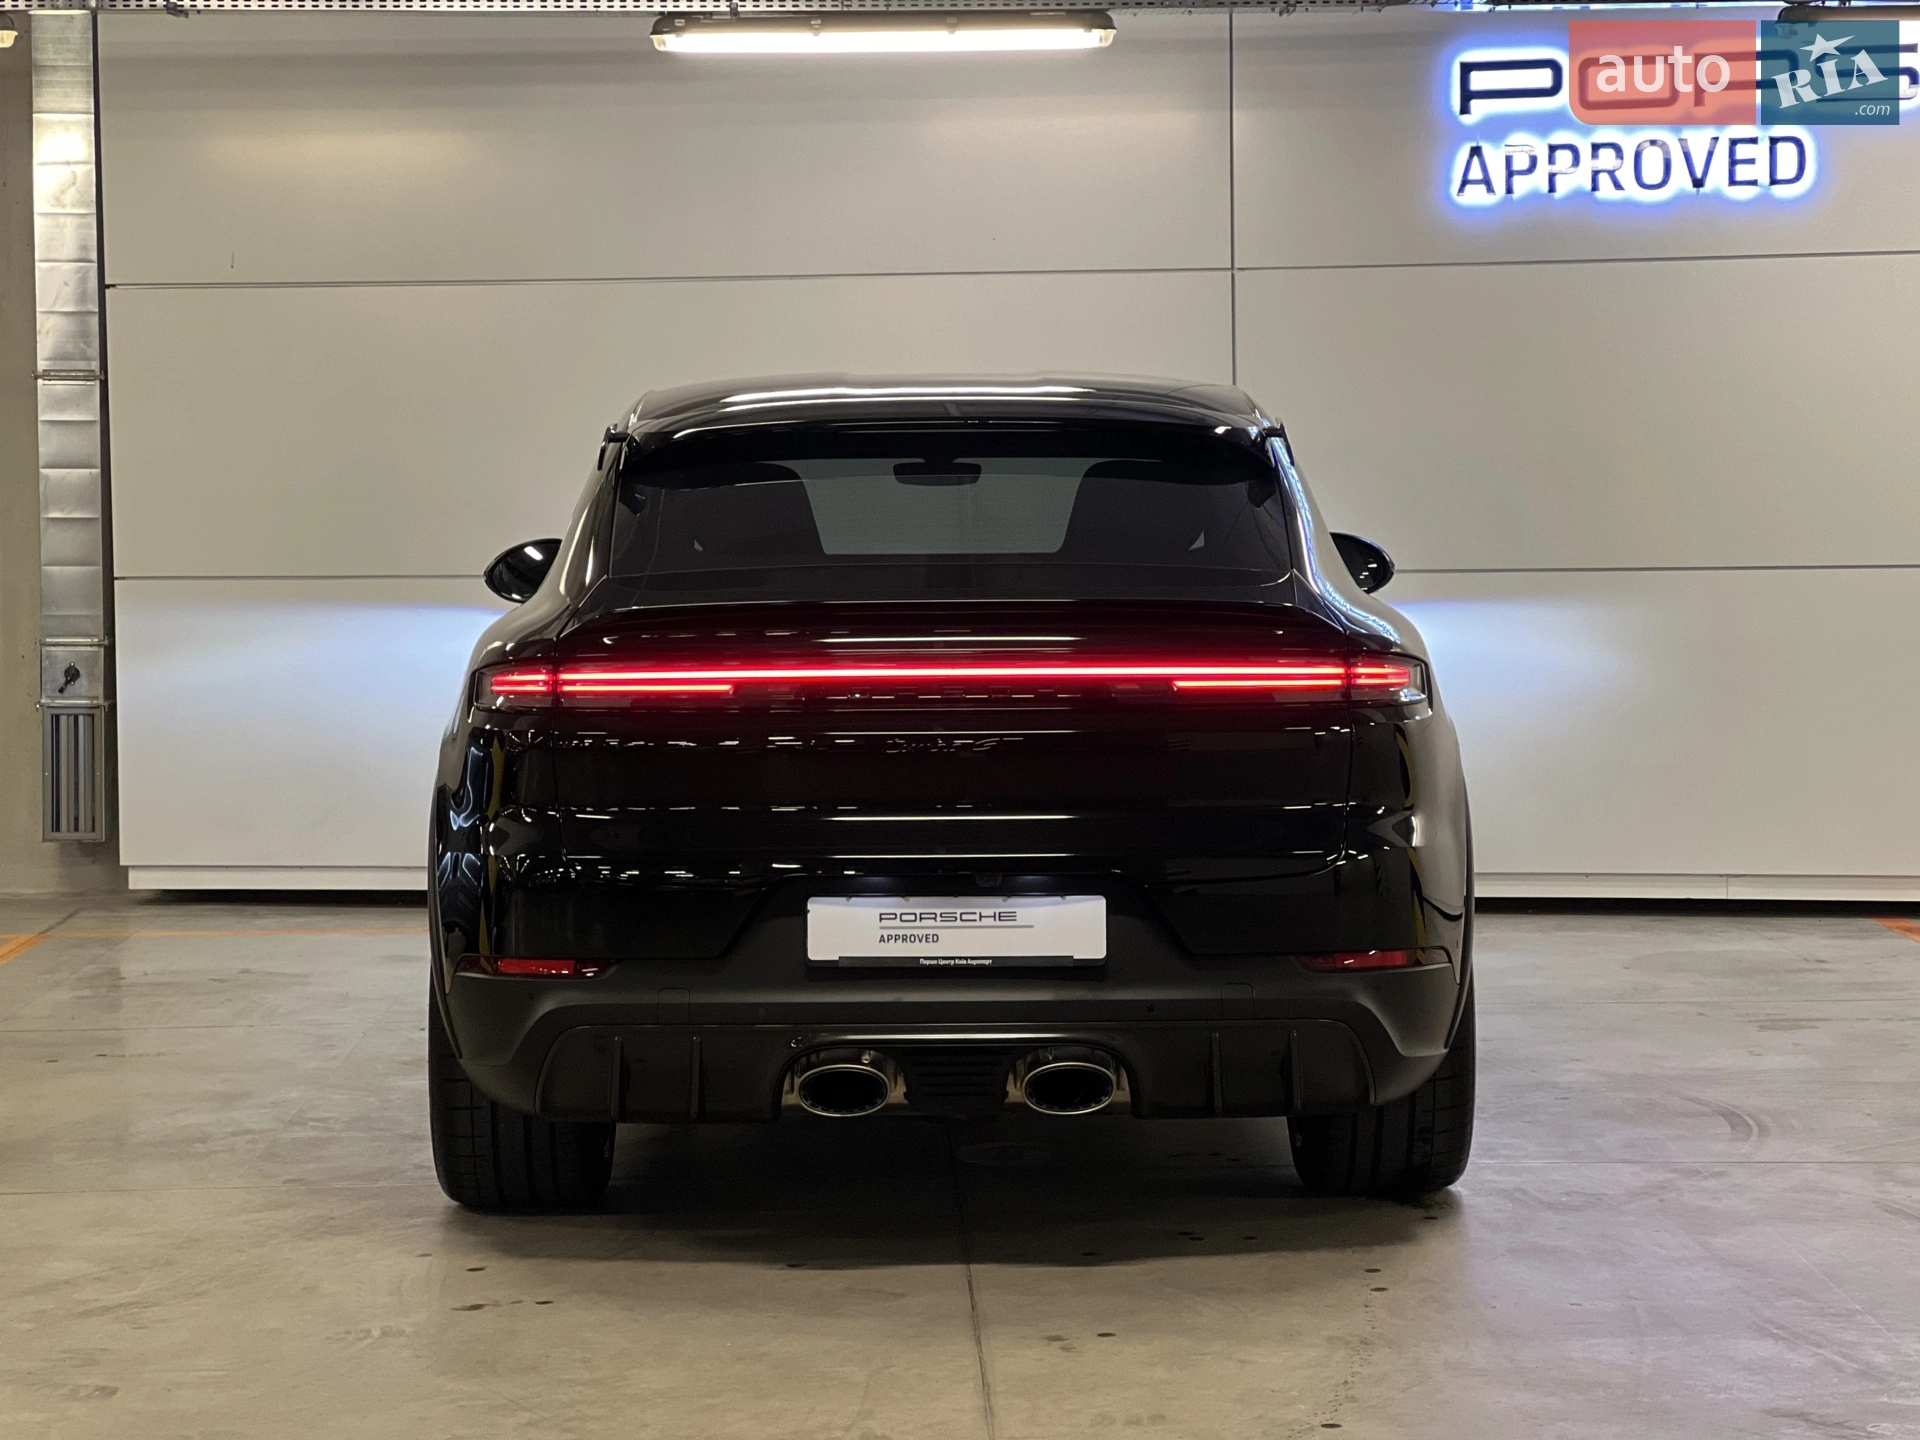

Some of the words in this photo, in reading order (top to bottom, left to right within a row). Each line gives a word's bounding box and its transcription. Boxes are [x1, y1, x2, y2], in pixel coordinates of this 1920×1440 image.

[1456, 135, 1807, 197] APPROVED
[879, 911, 1017, 923] PORSCHE
[878, 933, 940, 944] APPROVED
